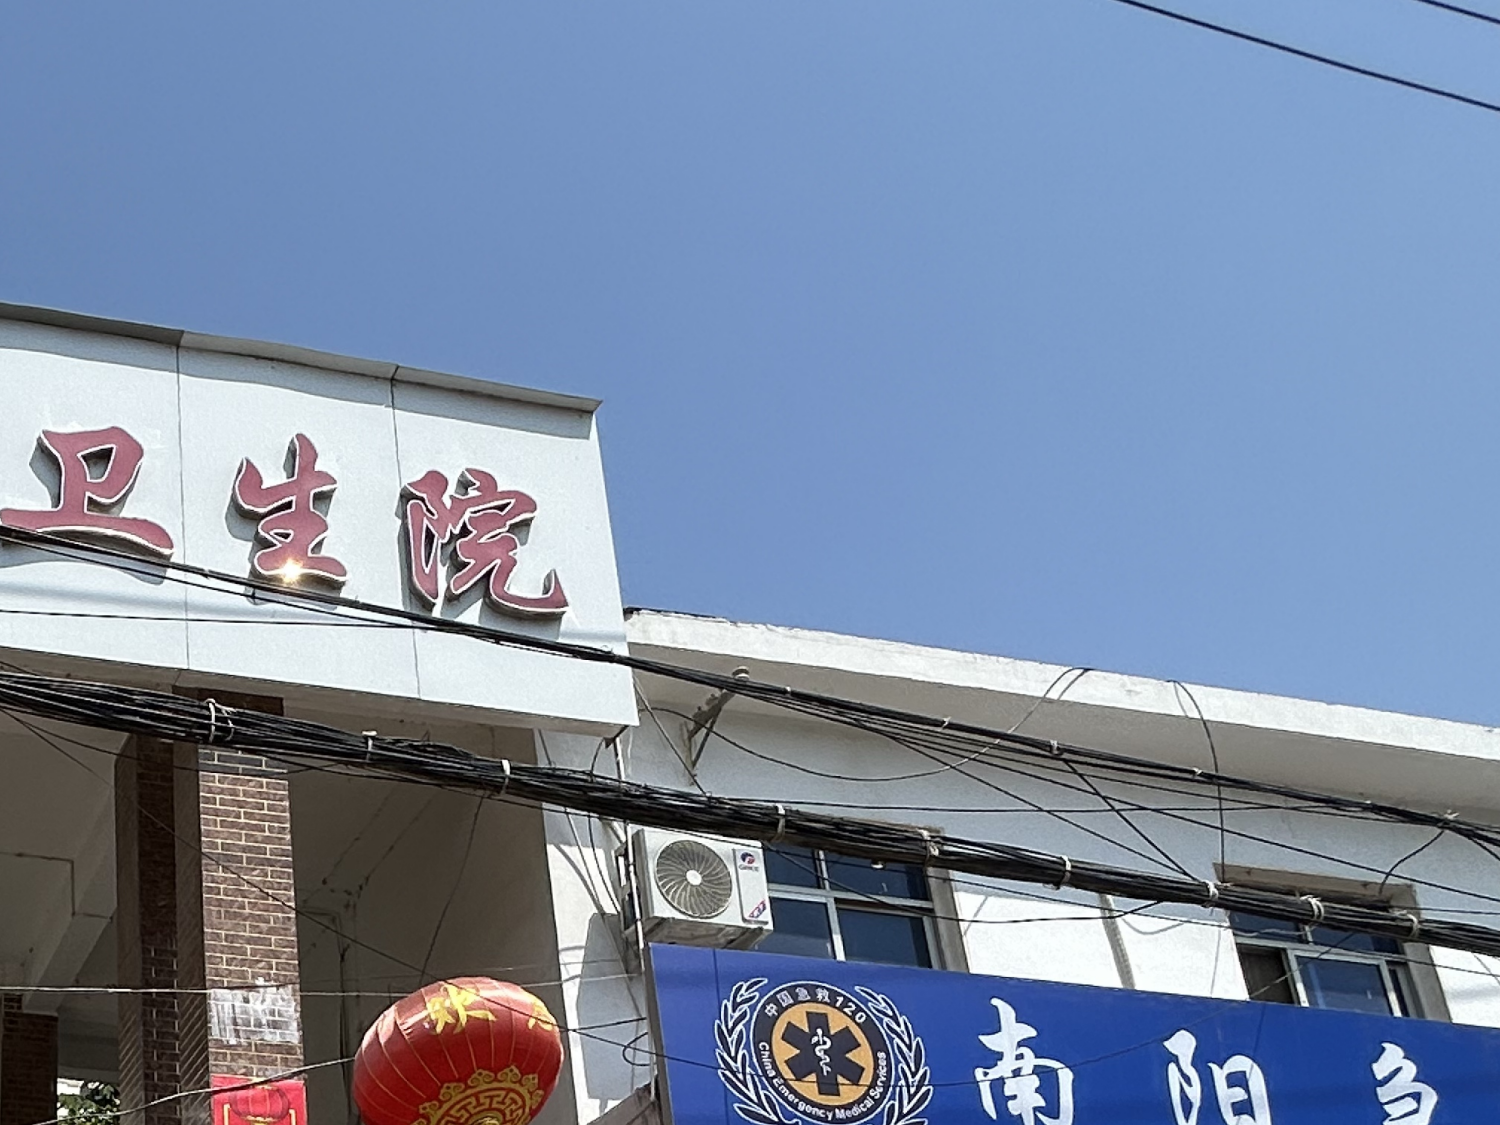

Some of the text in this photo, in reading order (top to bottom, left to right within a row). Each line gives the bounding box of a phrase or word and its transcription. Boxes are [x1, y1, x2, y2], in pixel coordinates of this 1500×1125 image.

[764, 987, 867, 1024] 中国急救120
[758, 1041, 887, 1121] China Emergency Medical Services
